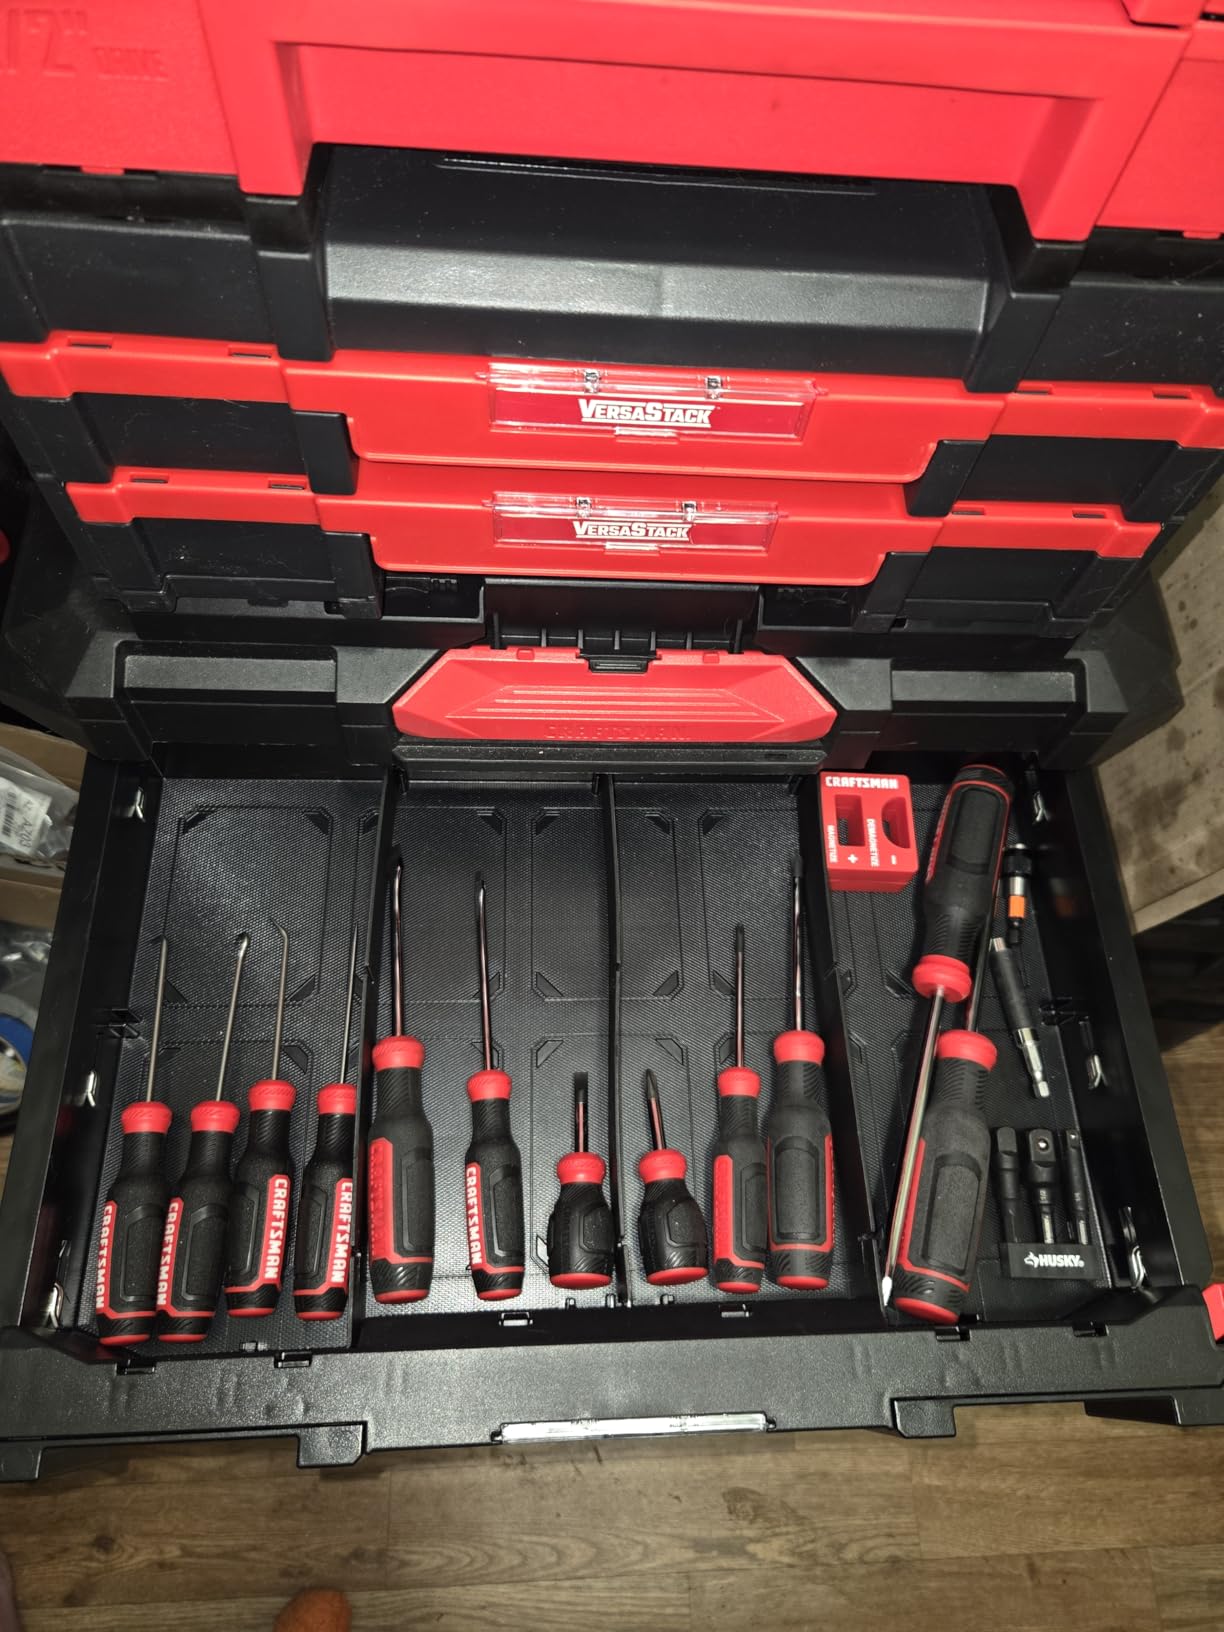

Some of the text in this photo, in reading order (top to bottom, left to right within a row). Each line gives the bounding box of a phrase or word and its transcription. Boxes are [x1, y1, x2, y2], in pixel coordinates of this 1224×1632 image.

[825, 776, 898, 789] CRAFTSMAN
[96, 1205, 112, 1308] CRAFTSMAN
[157, 1202, 178, 1305] CRAFTSMAN
[264, 1178, 288, 1279] CRAFTSMAN
[331, 1182, 353, 1283] CRAFTSMAN
[467, 1167, 482, 1264] CRAFTSMAN
[1039, 1254, 1080, 1268] HUSKY
